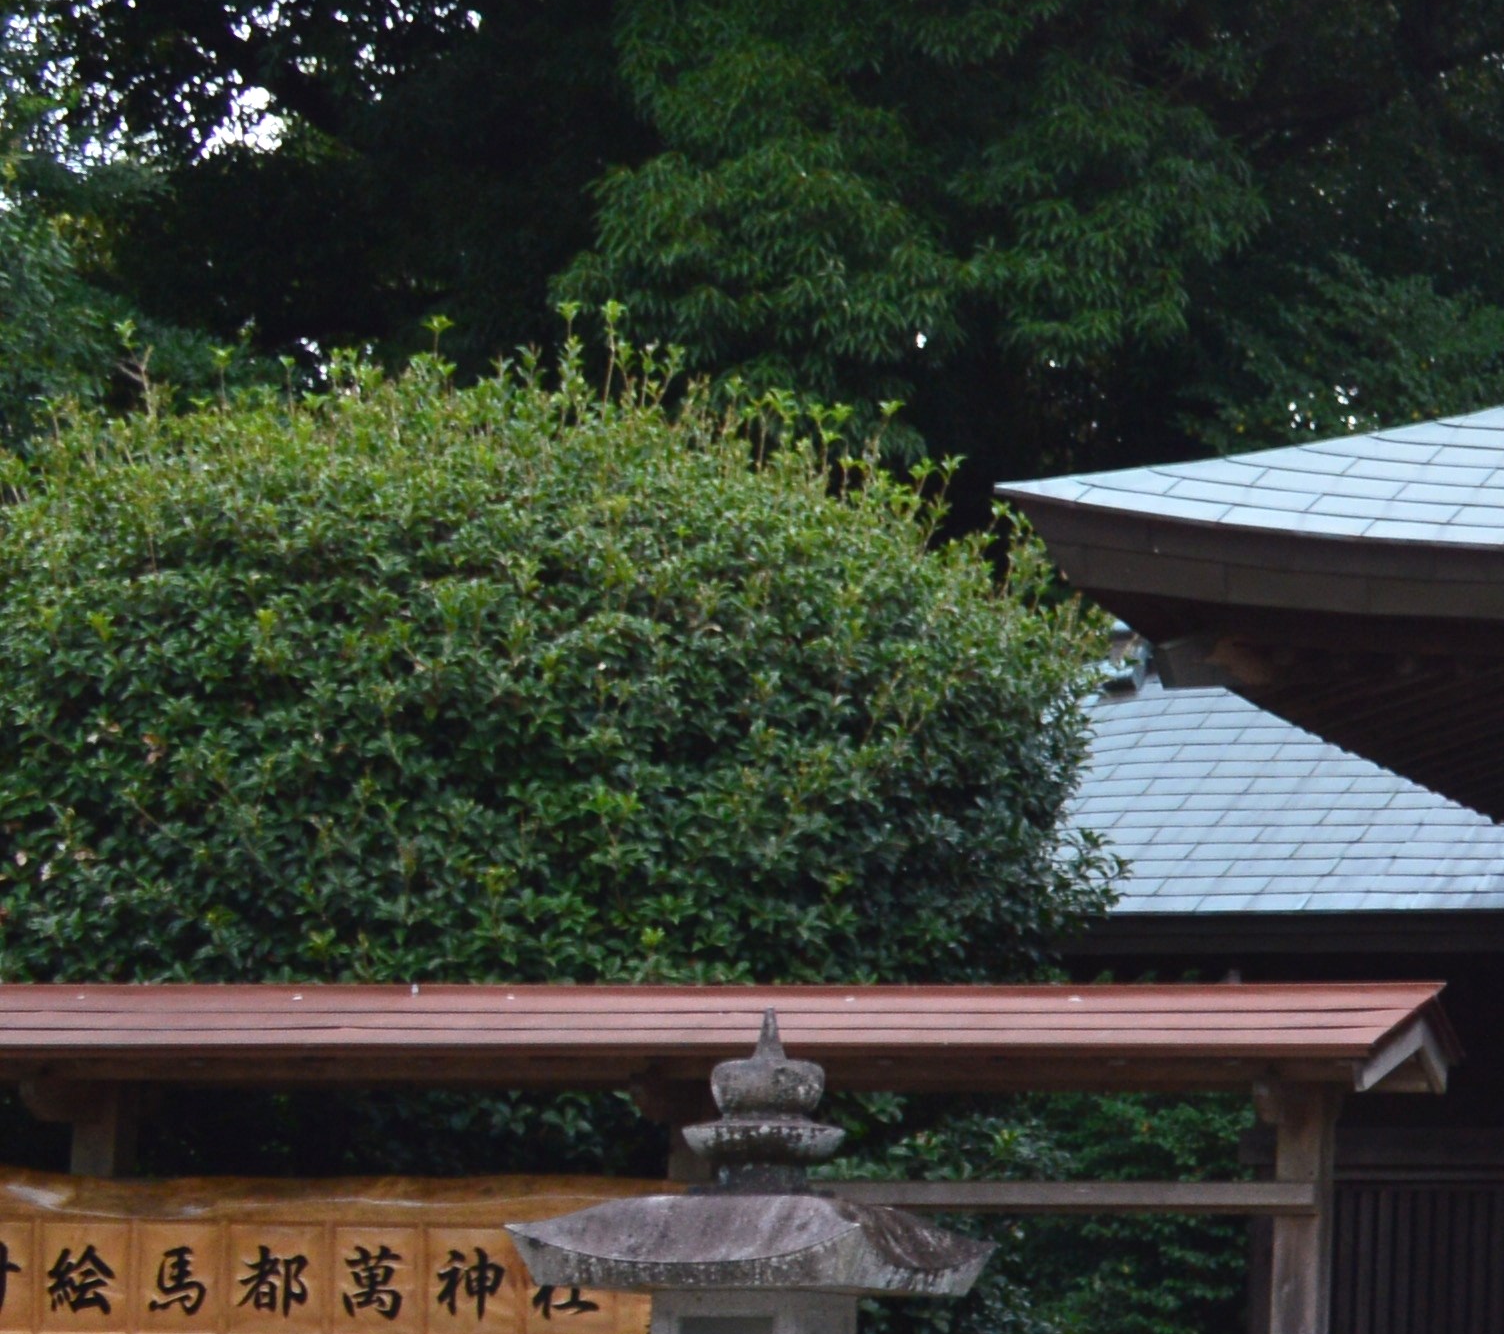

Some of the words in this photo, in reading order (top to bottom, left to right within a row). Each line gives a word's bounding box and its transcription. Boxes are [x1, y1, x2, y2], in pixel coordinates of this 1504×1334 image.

[0, 1240, 600, 1322] 絵馬都萬神
